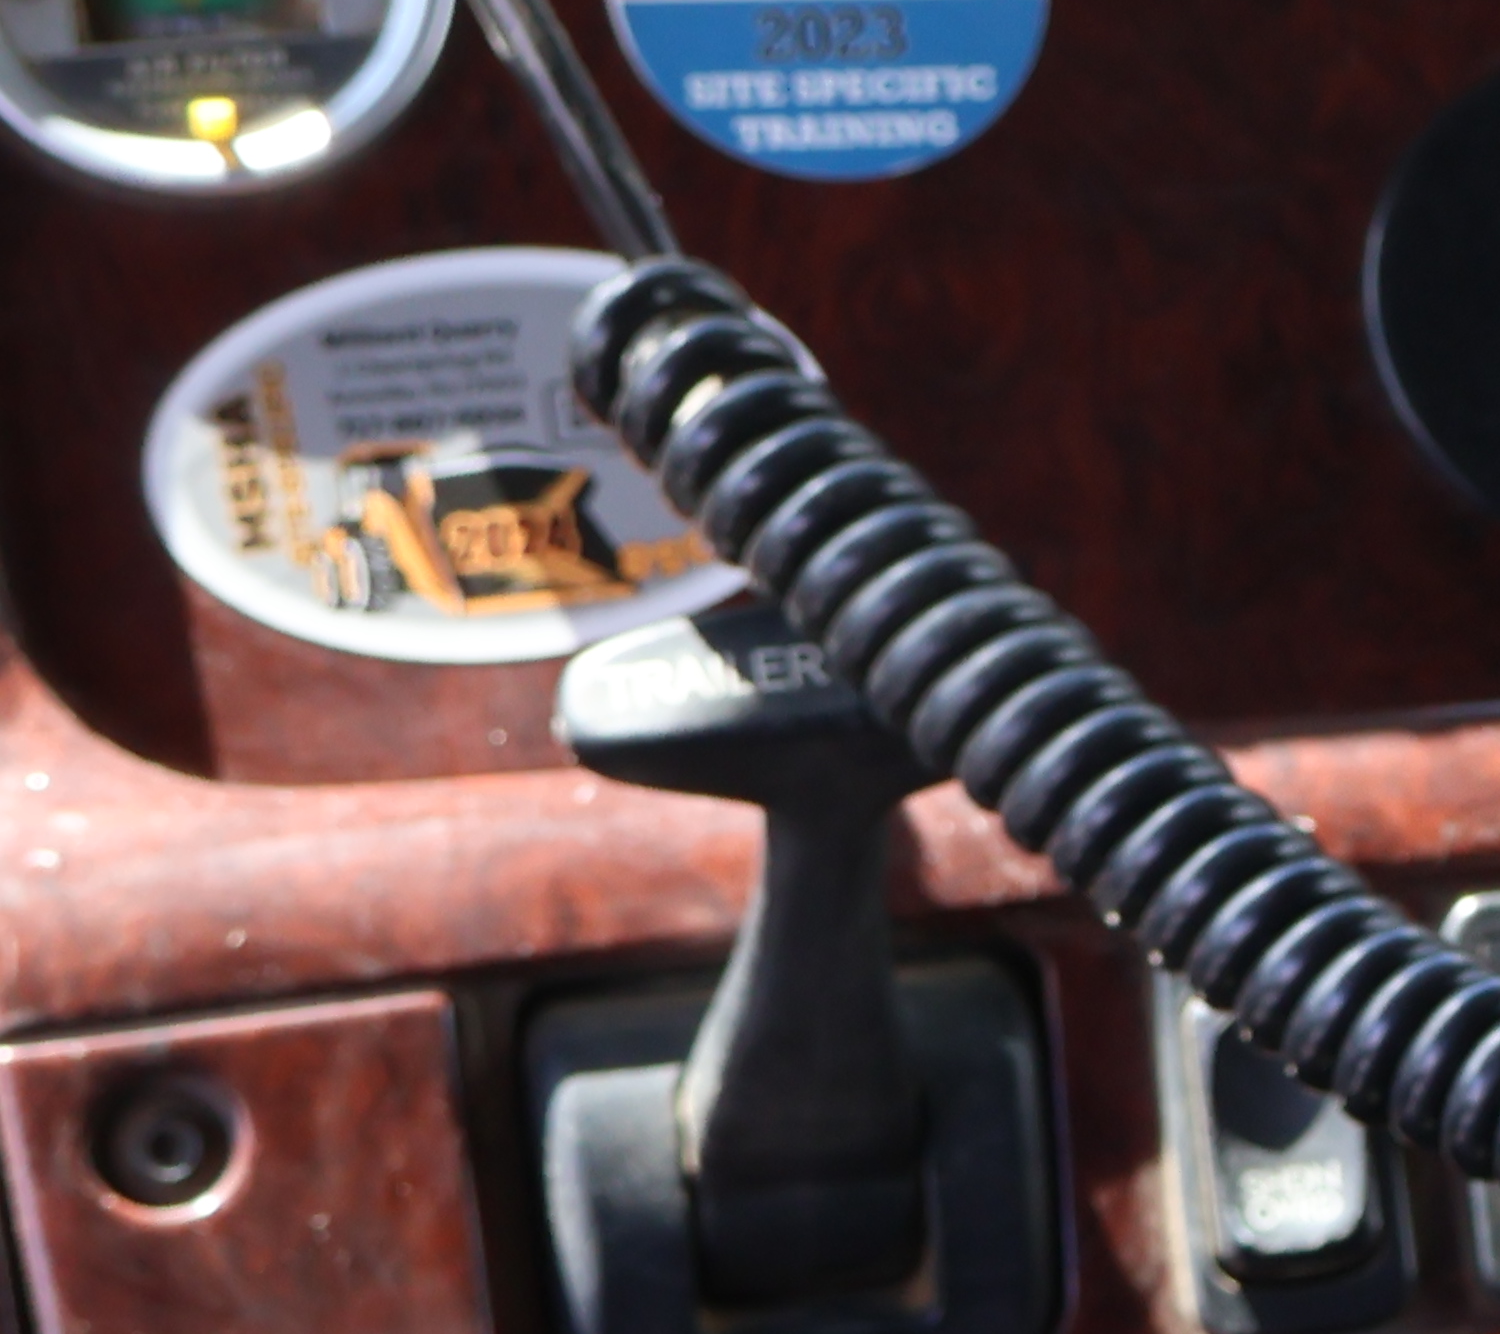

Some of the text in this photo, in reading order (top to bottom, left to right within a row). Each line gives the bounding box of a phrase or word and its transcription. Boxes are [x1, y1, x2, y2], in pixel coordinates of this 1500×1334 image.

[760, 6, 909, 60] 2023
[687, 64, 997, 108] SITE SPECIFIC
[732, 111, 957, 150] TRAINING
[597, 641, 832, 714] TRAILER
